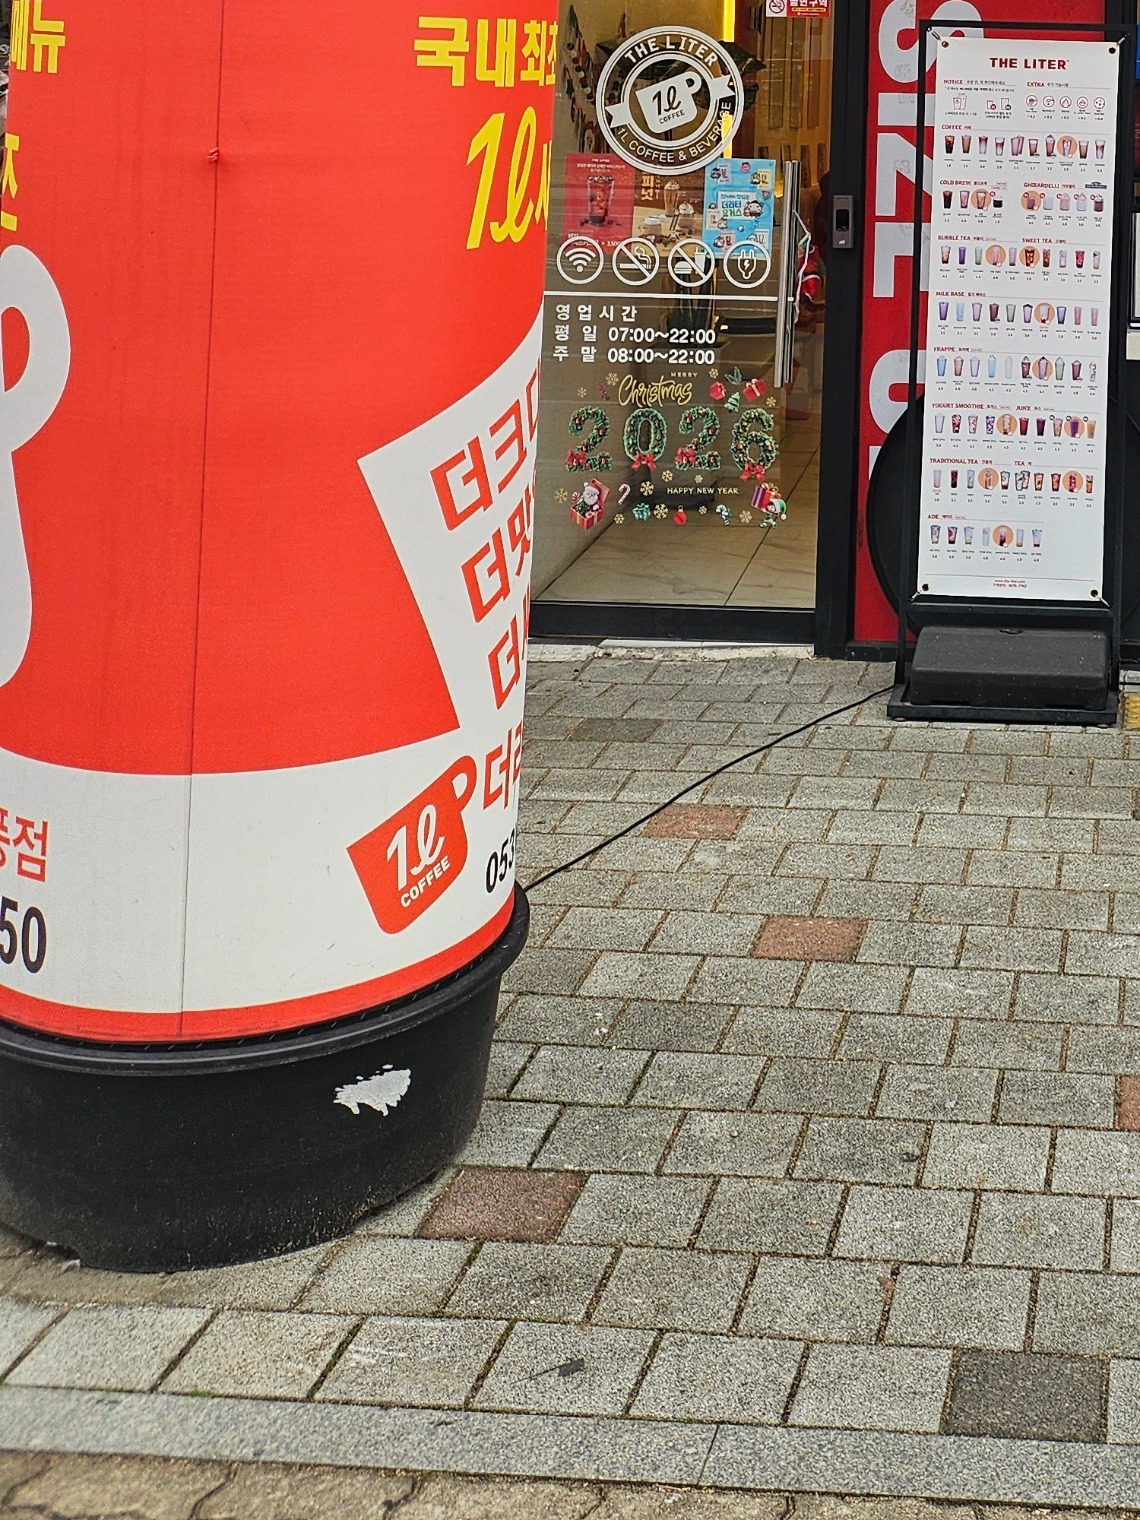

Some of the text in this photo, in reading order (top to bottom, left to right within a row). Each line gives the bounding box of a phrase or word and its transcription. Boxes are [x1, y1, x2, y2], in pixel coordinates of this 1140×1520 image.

[624, 35, 719, 67] THE LITER
[989, 57, 1067, 71] THE LITER
[658, 109, 686, 125] COFFEE
[628, 140, 675, 163] COFFEE
[678, 150, 687, 161] &
[689, 101, 732, 158] BEVERAGE
[555, 304, 638, 323] 영업시간
[554, 325, 716, 345] 평일 07:00~22:00
[552, 345, 715, 365] 주말 08:00~22:00
[618, 374, 694, 408] Christmas
[564, 405, 780, 482] 2026
[666, 486, 740, 495] HAPPY NEW YEAR
[400, 854, 451, 908] COFFEE
